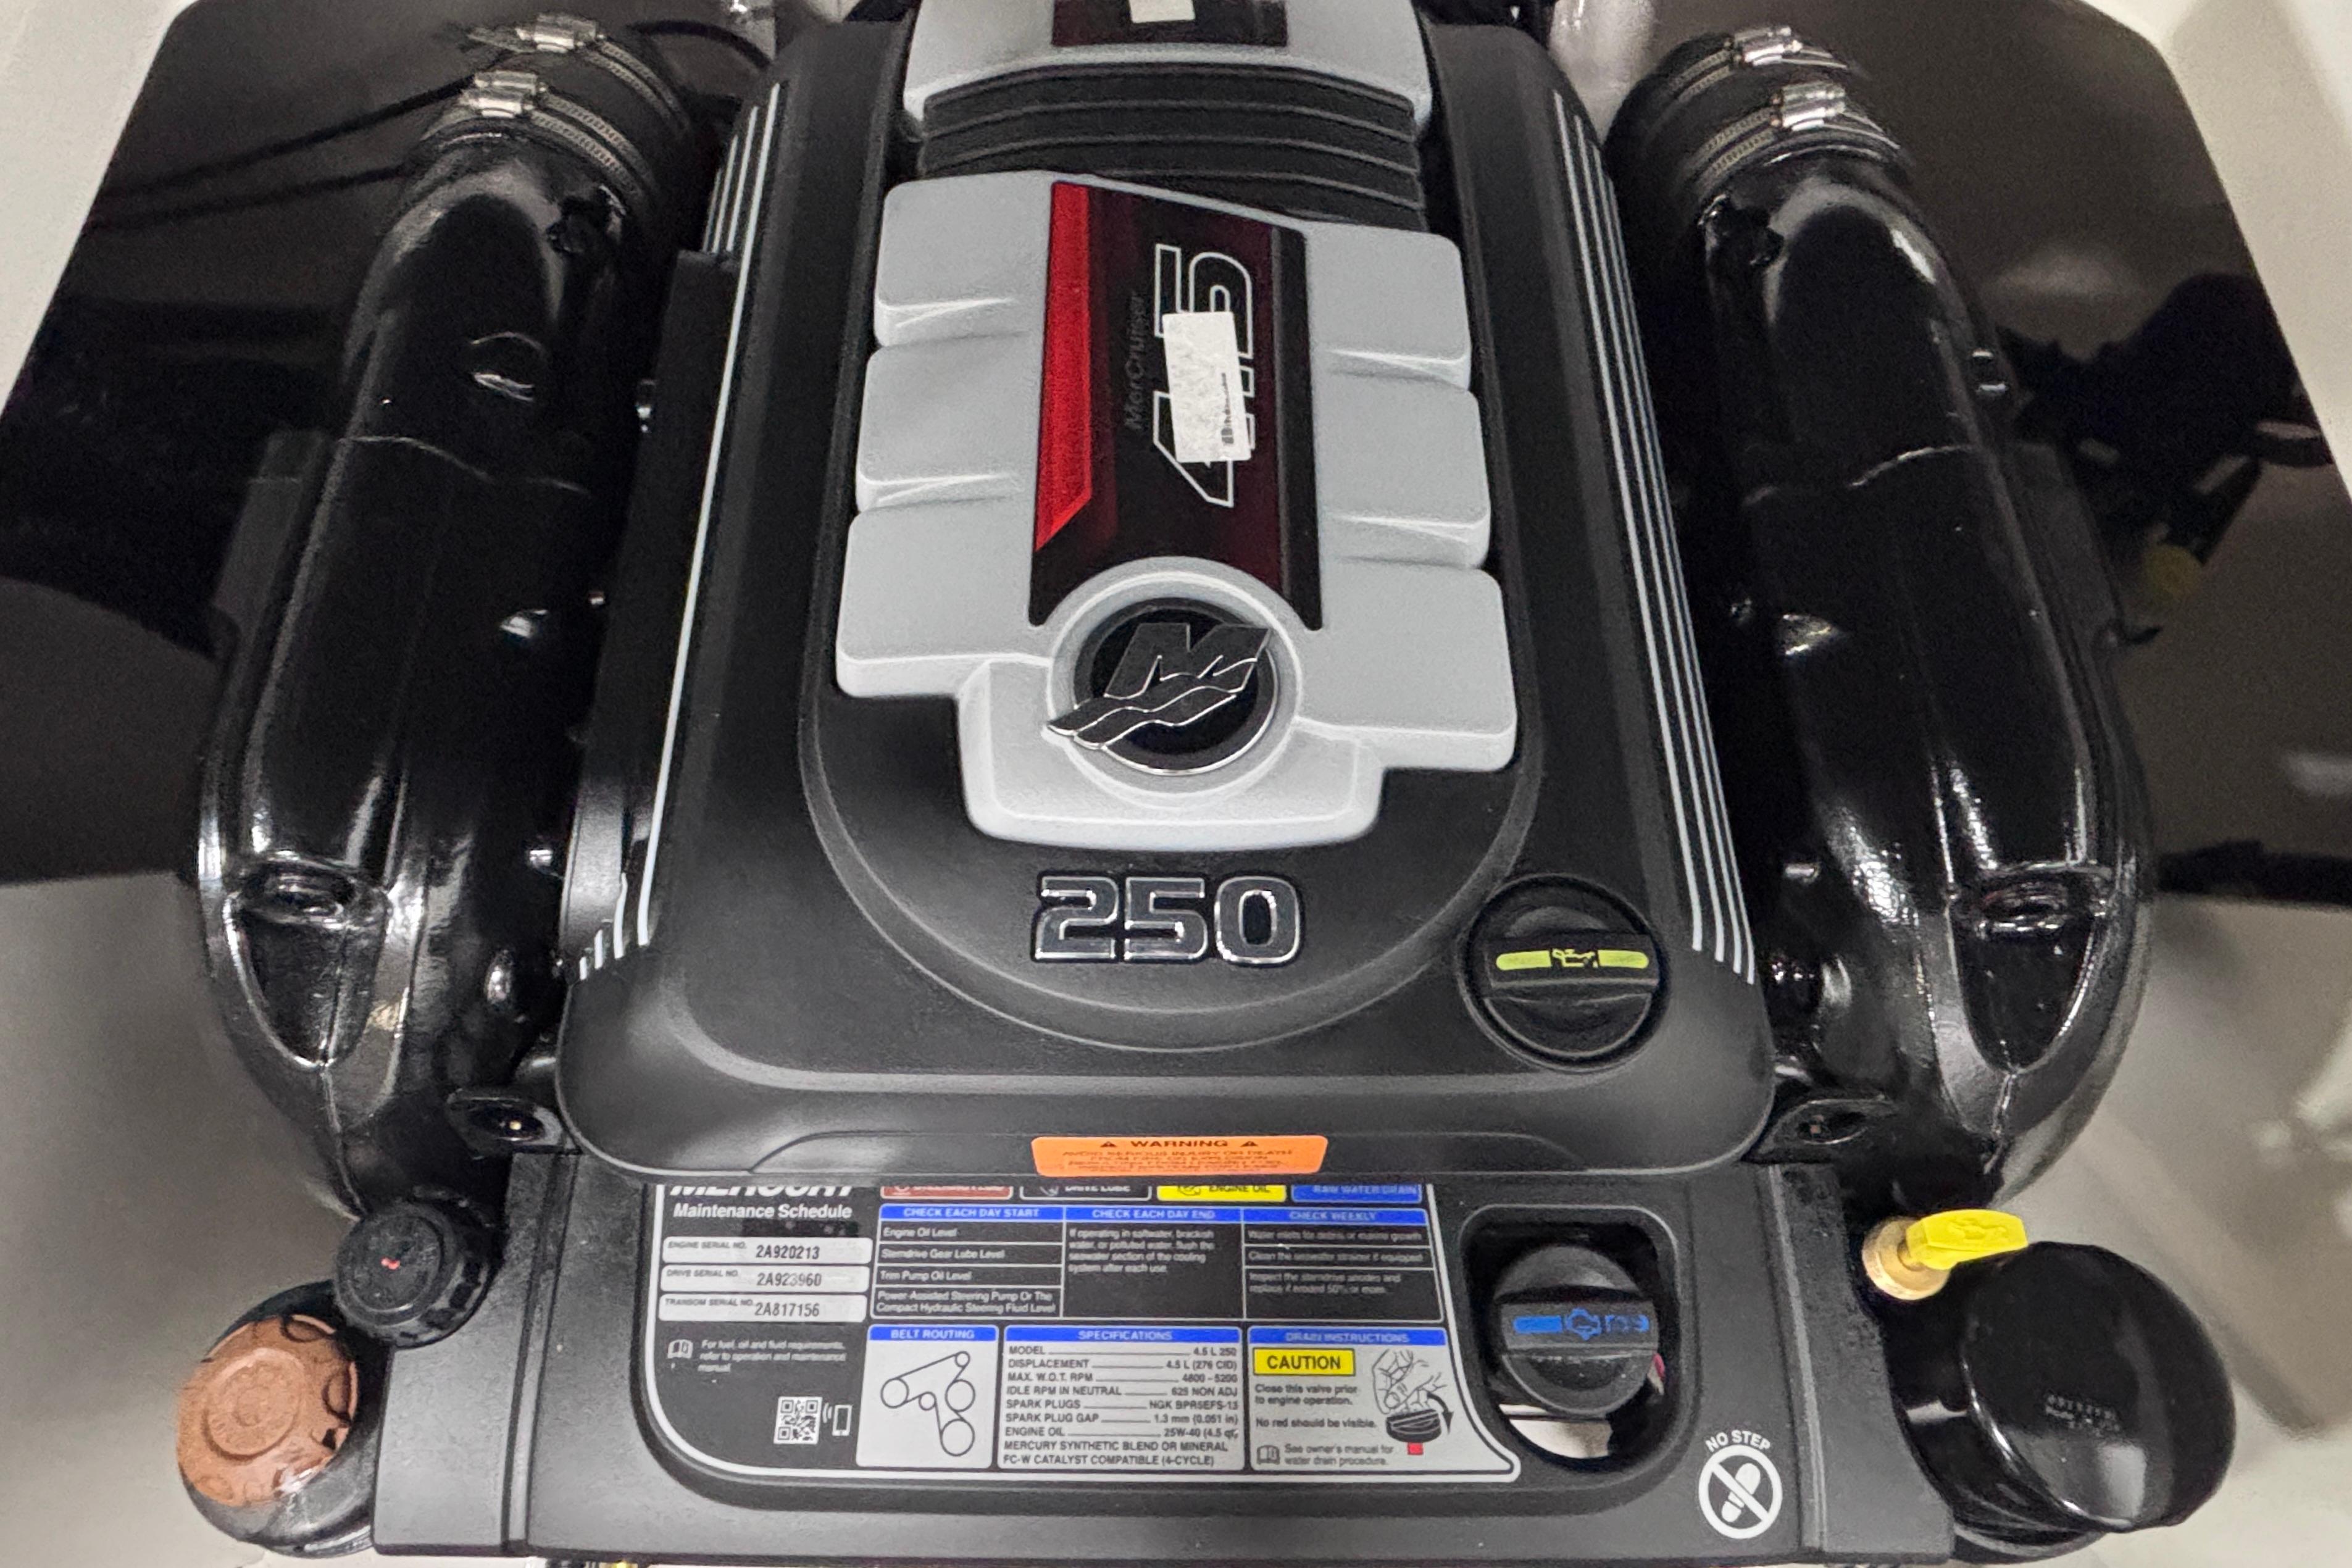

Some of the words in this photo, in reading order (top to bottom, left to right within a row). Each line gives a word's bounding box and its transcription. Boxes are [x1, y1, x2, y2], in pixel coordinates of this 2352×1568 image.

[1033, 874, 1301, 965] 250
[673, 1203, 775, 1218] Maintenance
[778, 1203, 853, 1219] Schedule
[903, 1208, 942, 1217] CHECK
[945, 1208, 977, 1217] EACH
[979, 1208, 1001, 1217] DAY
[1004, 1208, 1040, 1217] START
[1092, 1209, 1130, 1219] CHECK
[1133, 1210, 1164, 1219] EACH
[1167, 1210, 1189, 1219] DAY
[1191, 1210, 1216, 1219] END
[1289, 1211, 1328, 1220] CHECK
[1330, 1211, 1376, 1220] WEEKLY
[883, 1227, 915, 1239] Engine
[917, 1227, 930, 1236] Oil
[932, 1227, 957, 1237] Level
[667, 1241, 699, 1249] ENGINE
[701, 1241, 730, 1249] SERIAL
[756, 1244, 820, 1260] 2A920213
[929, 1249, 953, 1259] Gear
[954, 1250, 978, 1259] Lube
[980, 1250, 1005, 1259] Level
[666, 1269, 691, 1277] DRIVE
[694, 1269, 724, 1277] SERIAL
[756, 1272, 822, 1287] 2A923960
[902, 1271, 929, 1282] Pump
[930, 1270, 945, 1280] Oil
[946, 1271, 972, 1280] Level
[991, 1291, 1018, 1302] Pump
[1034, 1291, 1053, 1301] The
[665, 1298, 707, 1306] TRANSOM
[709, 1298, 738, 1306] SERIAL
[754, 1301, 820, 1317] 2A817156
[1030, 1304, 1056, 1314] Level
[891, 1329, 920, 1339] BELT
[922, 1329, 975, 1339] ROUTING
[1078, 1330, 1172, 1340] SPECIFICATIONS
[1324, 1333, 1409, 1343] INSTRUCTIONS
[1009, 1346, 1046, 1355] MODEL
[1193, 1347, 1207, 1357] 4.5
[1210, 1348, 1217, 1357] L
[1008, 1359, 1090, 1369] DISPLACEMENT
[1166, 1360, 1180, 1369] 4.5
[1183, 1360, 1190, 1369] L
[1266, 1356, 1341, 1370] CAUTION
[1007, 1372, 1033, 1382] MAX.
[1070, 1372, 1093, 1382] RPM
[1006, 1386, 1030, 1395] IDLE
[1033, 1386, 1056, 1395] RPM
[1059, 1386, 1069, 1395] IN
[1072, 1386, 1122, 1396] NEUTRAL
[1191, 1387, 1215, 1396] NON
[1217, 1387, 1238, 1396] ADJ
[1254, 1383, 1282, 1393] Close
[1285, 1383, 1303, 1393] this
[1306, 1384, 1332, 1393] valve
[1334, 1384, 1359, 1396] prior
[1006, 1399, 1041, 1409] SPARK
[1045, 1399, 1081, 1409] PLUGS
[1149, 1400, 1172, 1409] NGK
[1254, 1395, 1265, 1404] to
[1267, 1396, 1301, 1406] engine
[1303, 1396, 1353, 1406] operation.
[1006, 1413, 1041, 1422] SPARK
[1044, 1413, 1074, 1422] PLUG
[1076, 1413, 1099, 1423] GAP
[1154, 1414, 1169, 1424] 1.3
[1171, 1416, 1190, 1424] mm
[1256, 1418, 1269, 1427] No
[1272, 1418, 1288, 1427] red
[1291, 1418, 1325, 1428] should
[1327, 1418, 1340, 1427] be
[1342, 1419, 1377, 1428] visible.
[1005, 1427, 1045, 1437] ENGINE
[1048, 1427, 1065, 1437] OIL
[1163, 1428, 1201, 1437] 25W-40
[1004, 1440, 1057, 1450] MERCURY
[1059, 1441, 1119, 1450] SYNTHETIC
[1122, 1441, 1159, 1451] BLEND
[1161, 1441, 1177, 1451] OR
[1180, 1441, 1228, 1451] MINERAL
[1705, 1432, 1729, 1452] NO
[1731, 1430, 1770, 1449] STEP
[1283, 1443, 1303, 1453] See
[1306, 1444, 1341, 1453] owner's
[1344, 1444, 1378, 1453] manual
[1380, 1444, 1394, 1454] for
[1003, 1454, 1030, 1464] FC-W
[1033, 1454, 1088, 1464] CATALYST
[1090, 1454, 1159, 1465] COMPATIBLE
[1161, 1455, 1215, 1467] (4-CYCLE)
[1285, 1456, 1311, 1465] water
[1313, 1456, 1337, 1465] drain
